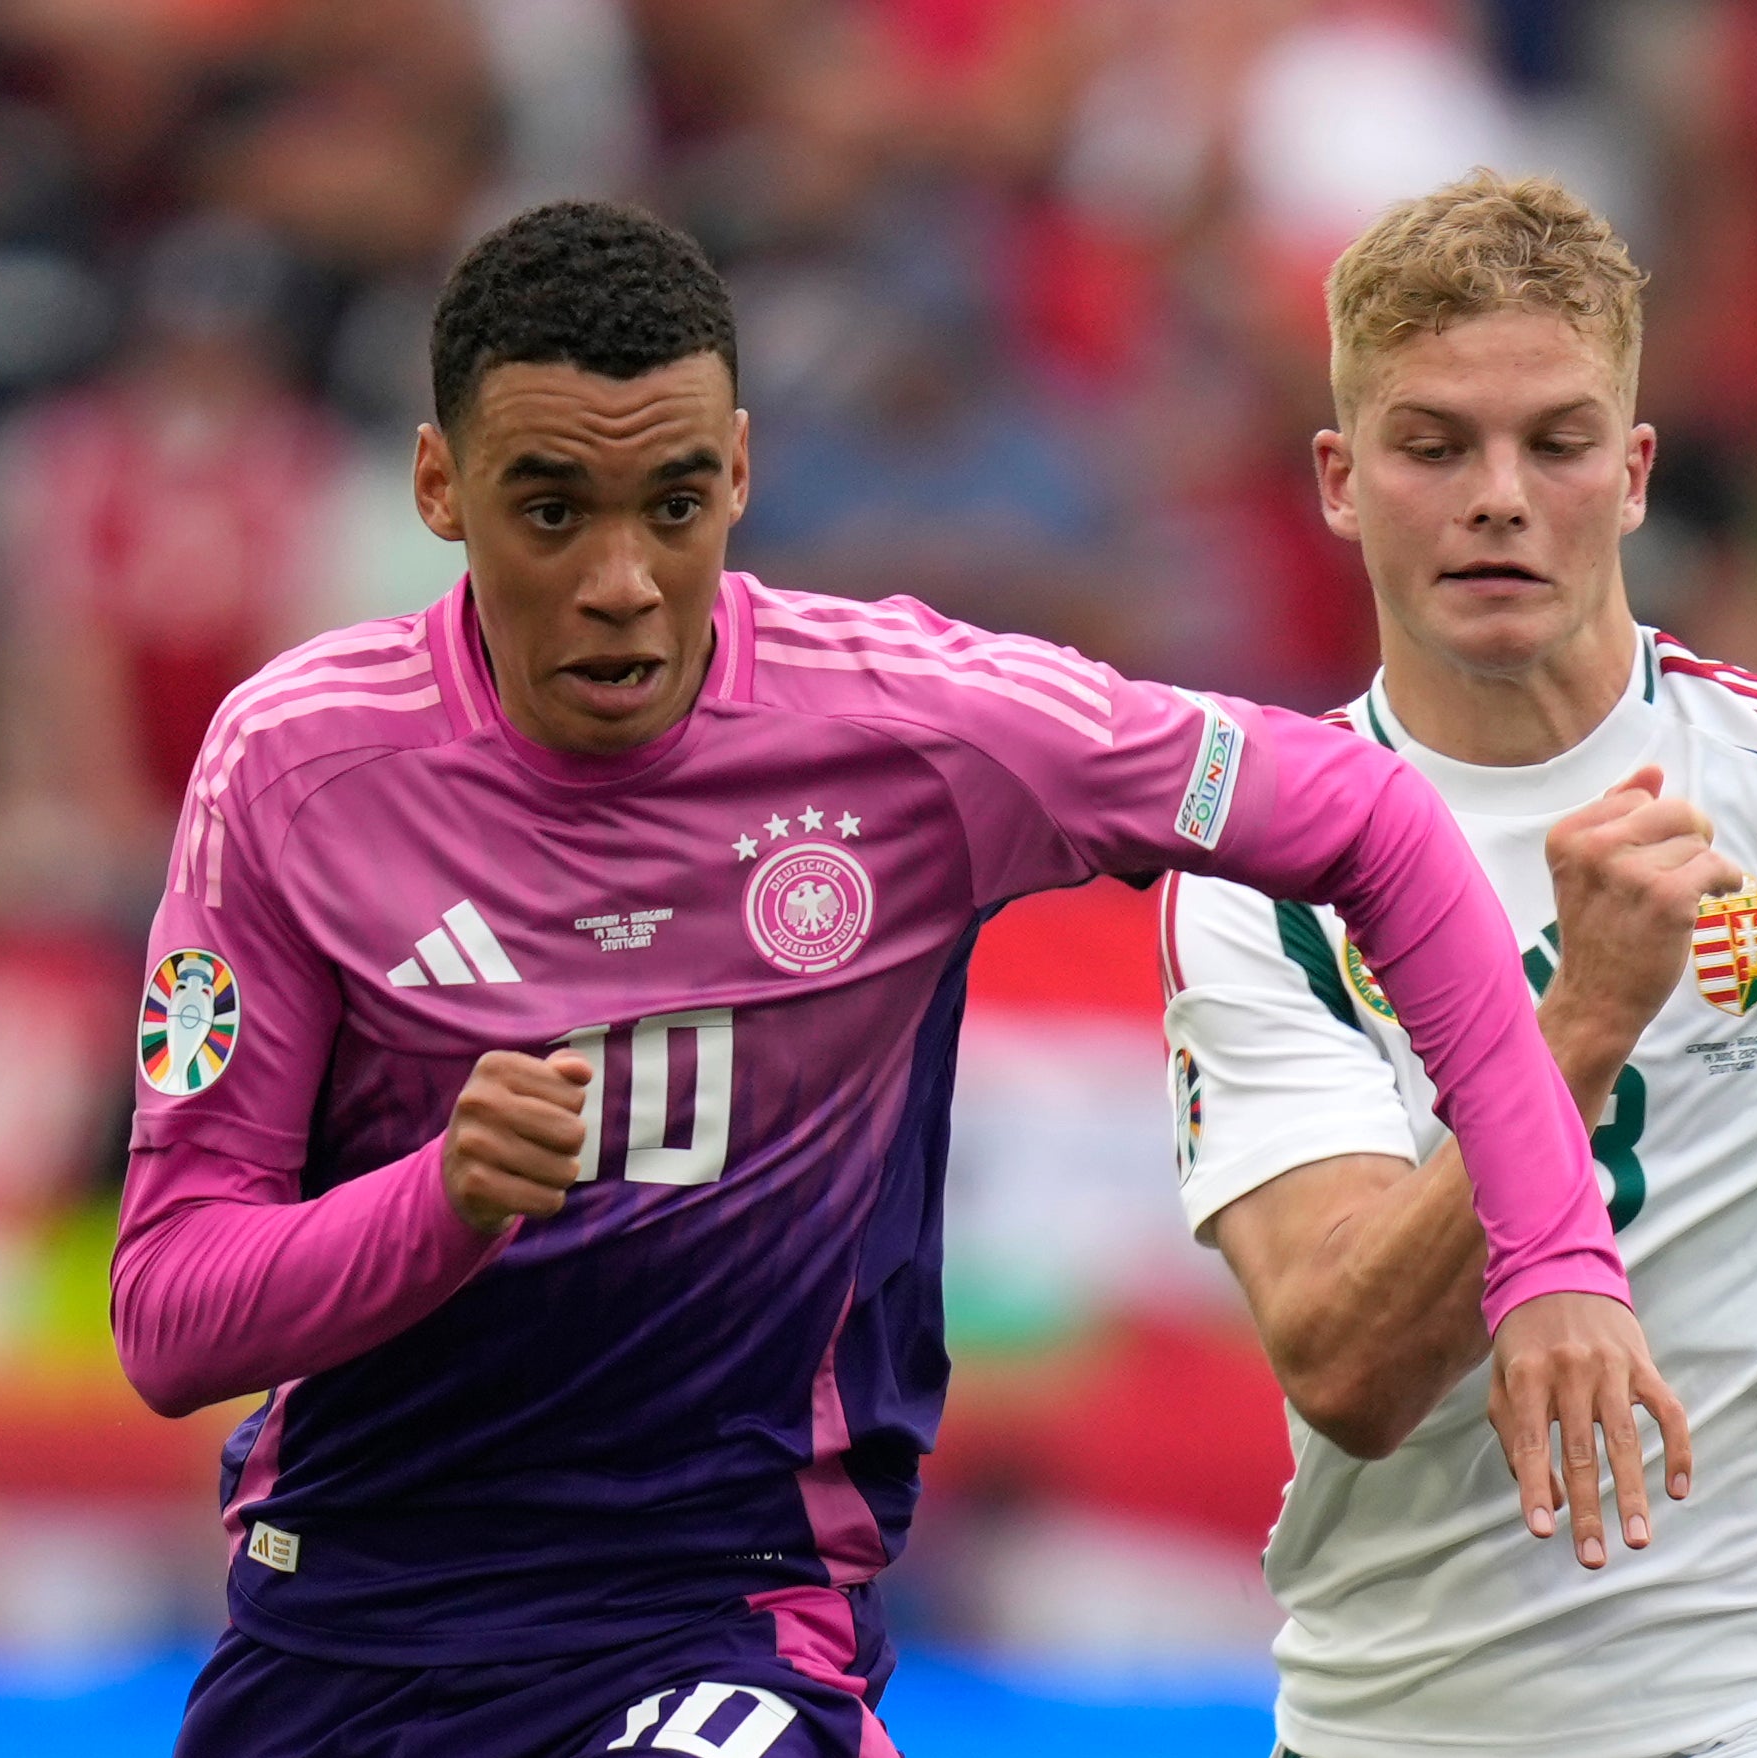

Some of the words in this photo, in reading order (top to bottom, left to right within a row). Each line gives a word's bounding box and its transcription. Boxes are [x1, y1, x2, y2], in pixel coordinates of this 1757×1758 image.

[769, 860, 841, 892] DEUTSCHER
[574, 914, 620, 931] GERMANY
[630, 908, 673, 924] HUNGARY
[594, 928, 605, 940] 19
[606, 925, 629, 939] JUNE
[631, 923, 657, 936] 2024
[600, 935, 652, 952] STUTTGART
[771, 911, 856, 956] FUSSBALL-BUND
[545, 1006, 734, 1187] 10
